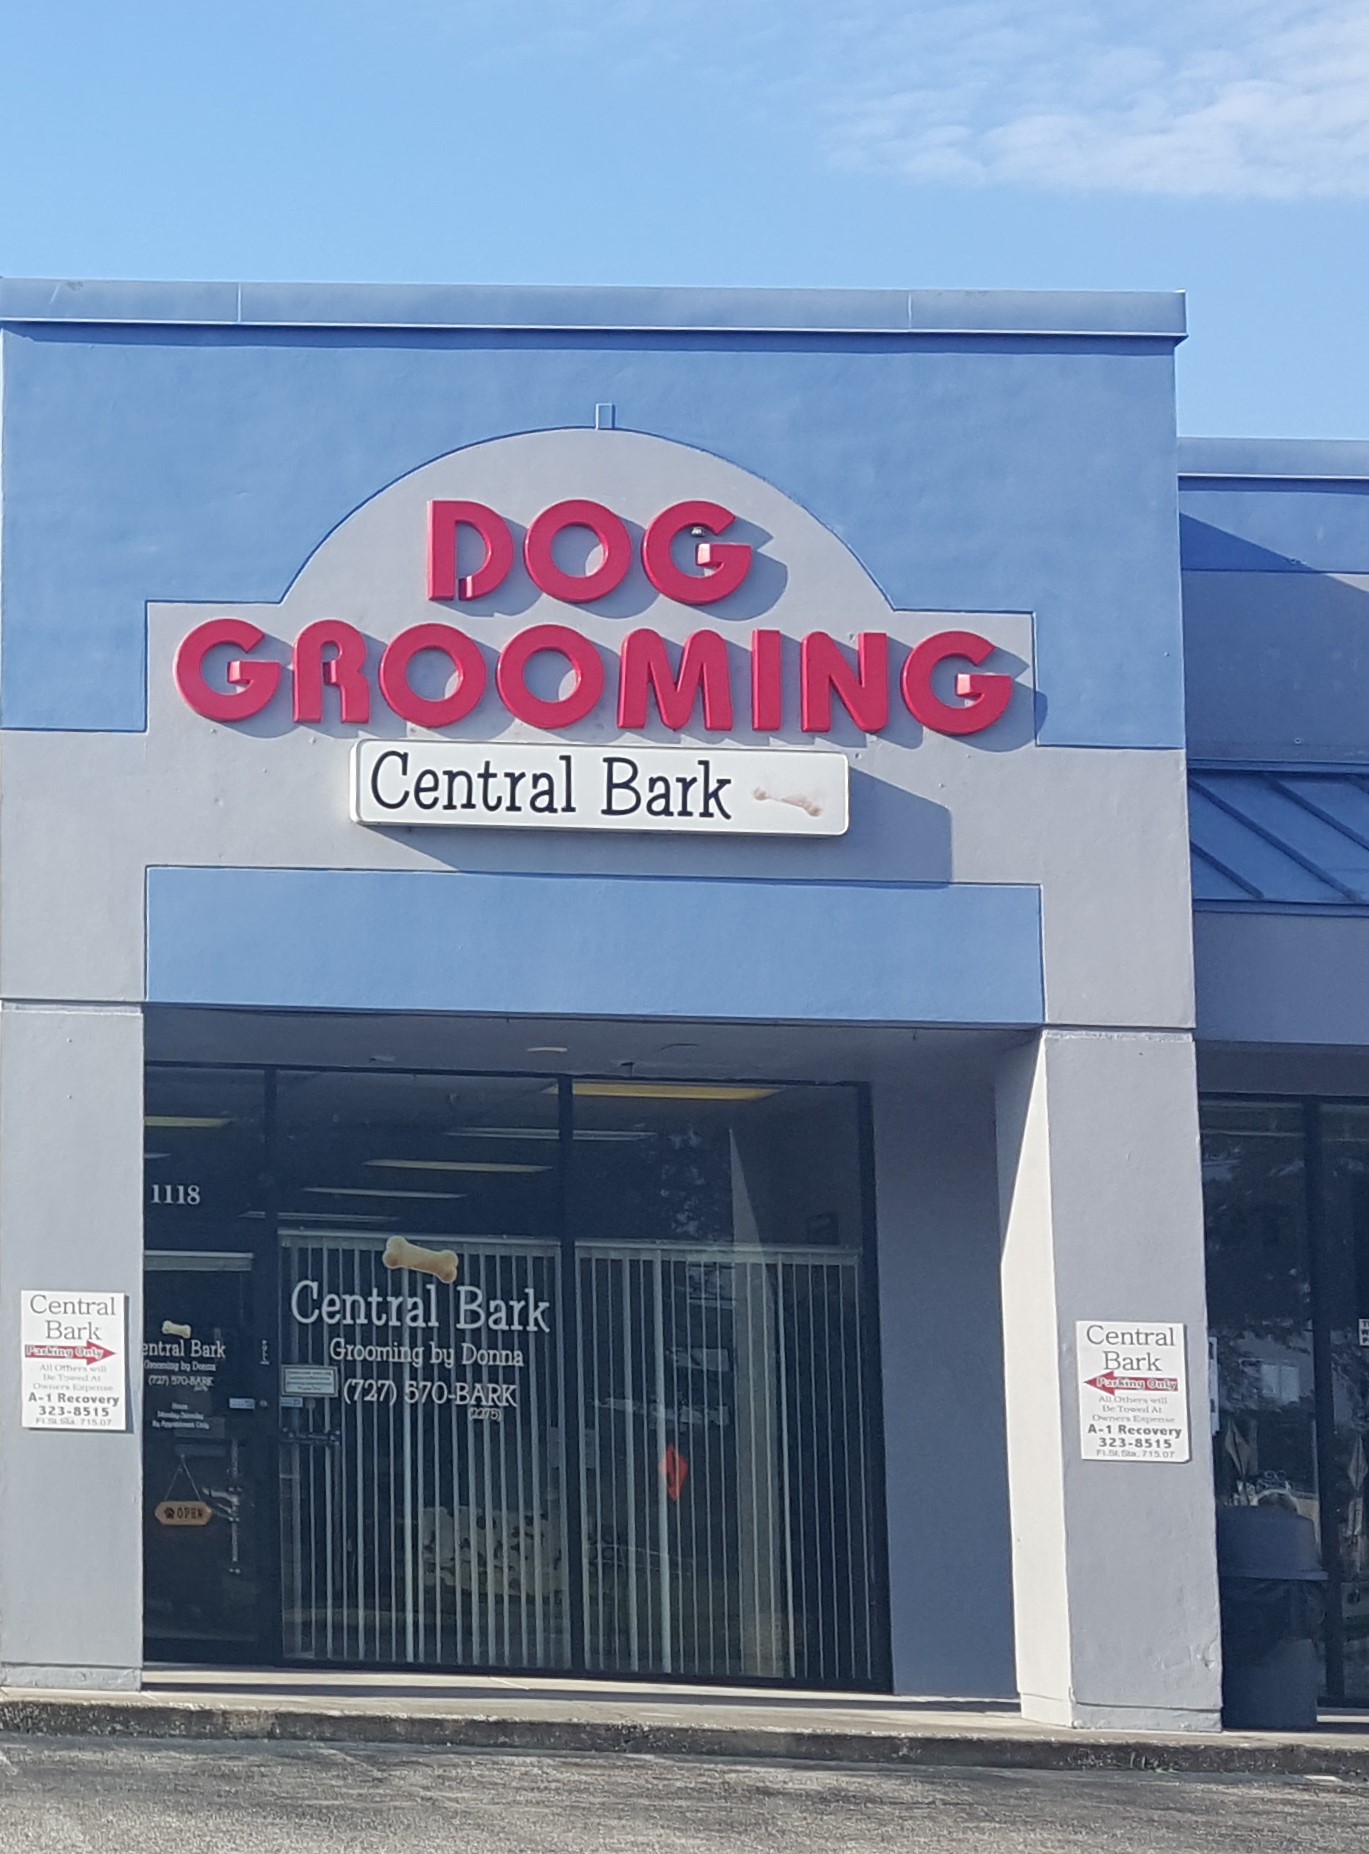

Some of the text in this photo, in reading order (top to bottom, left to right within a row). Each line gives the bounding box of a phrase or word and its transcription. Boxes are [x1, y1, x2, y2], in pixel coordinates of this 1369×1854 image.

[426, 499, 753, 606] DOG
[175, 617, 1012, 736] GROOMING
[370, 750, 733, 821] Central Bark
[150, 1184, 201, 1205] 1118
[30, 1294, 117, 1316] Central
[290, 1279, 551, 1334] Central Bark
[45, 1319, 102, 1341] Bark
[1086, 1324, 1176, 1347] Central
[26, 1345, 104, 1360] Parking Only
[143, 1340, 226, 1359] entral Bark
[329, 1337, 524, 1369] Grooming by Donna
[1103, 1350, 1162, 1372] Bark
[343, 1378, 397, 1405] (727)
[405, 1380, 518, 1408] 570-BARK
[1097, 1377, 1178, 1391] Parking Only
[28, 1392, 120, 1407] A-1 Recovery
[1113, 1395, 1148, 1404] Others
[1116, 1405, 1149, 1413] Towed
[39, 1406, 110, 1417] 323-8515
[1092, 1414, 1176, 1424] Owners Expense
[1087, 1423, 1182, 1439] A-1 Recovery
[1098, 1437, 1172, 1449] 323-8515
[177, 1506, 203, 1520] OPEN
